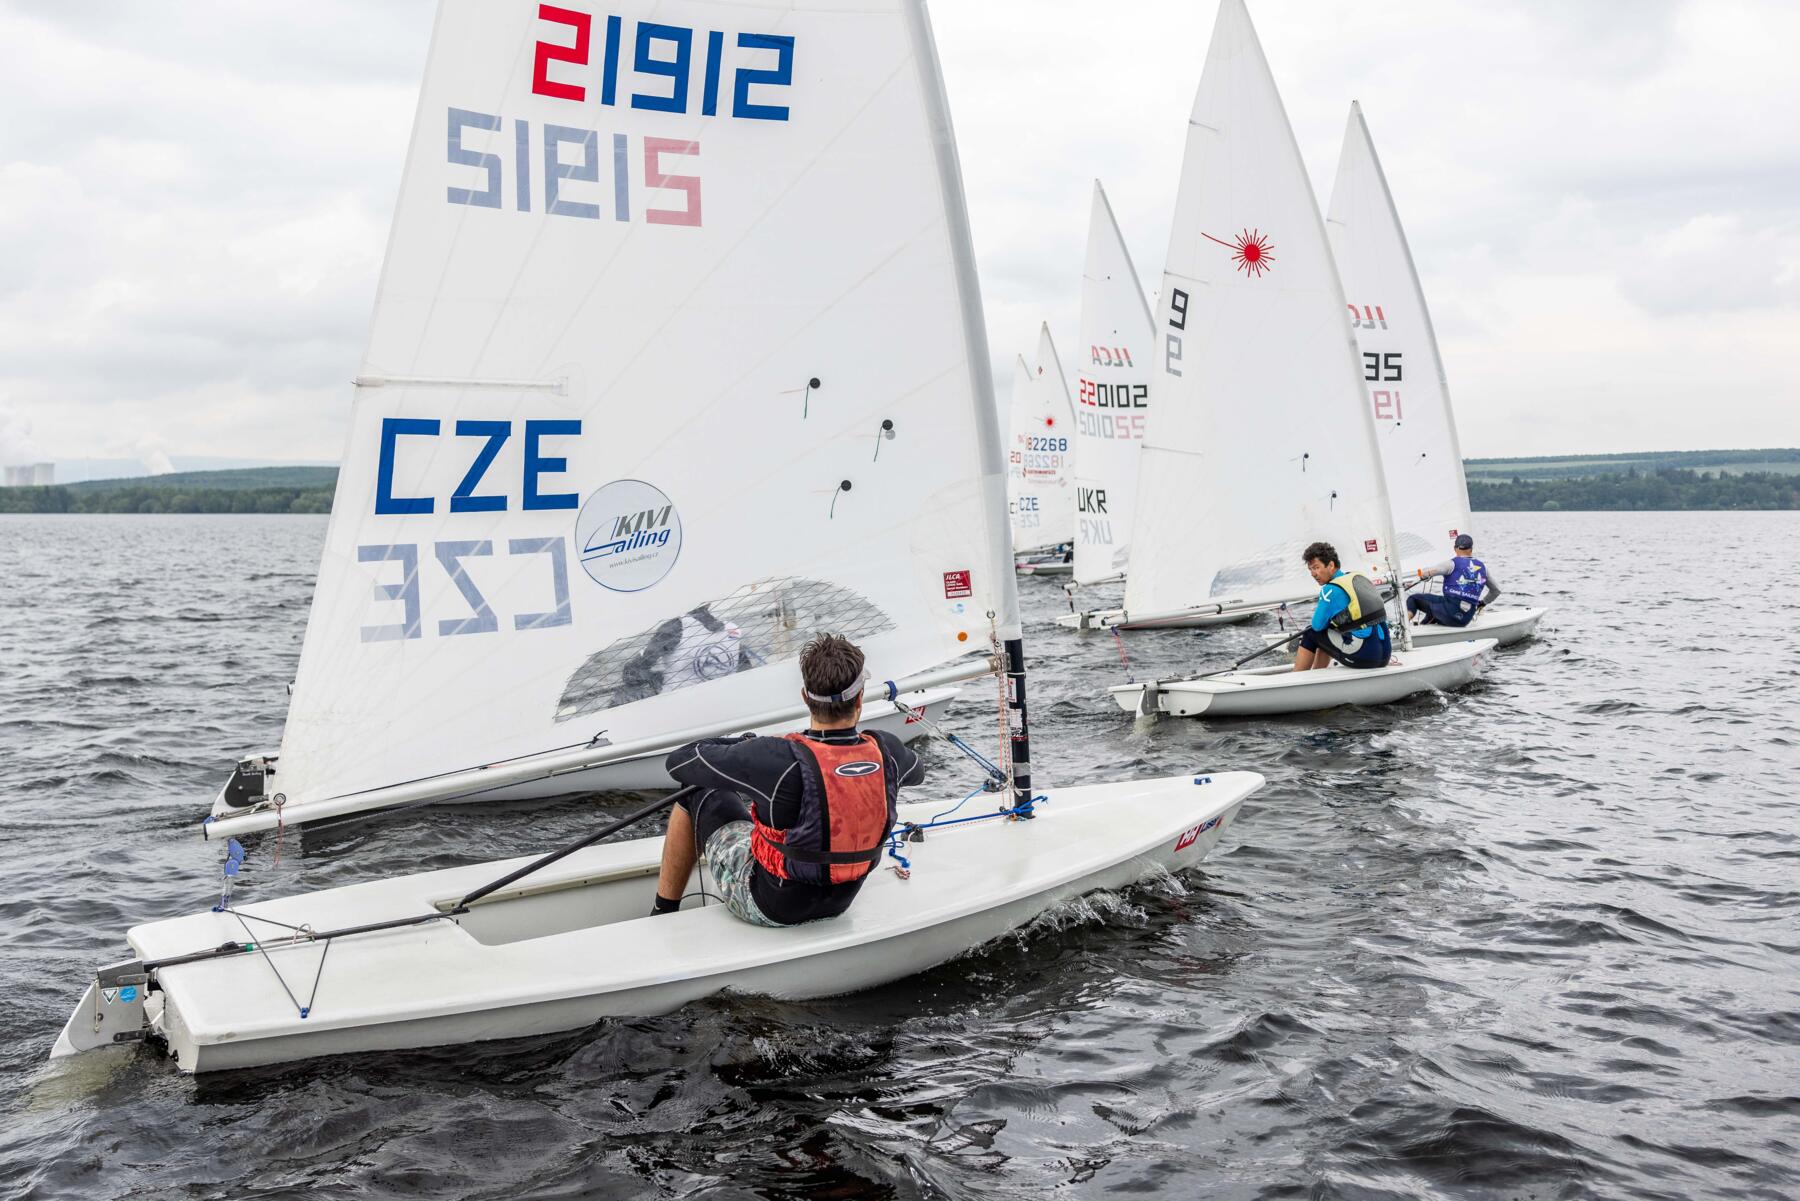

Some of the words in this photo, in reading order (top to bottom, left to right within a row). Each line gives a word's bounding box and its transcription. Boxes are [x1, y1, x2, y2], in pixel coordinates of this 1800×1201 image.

[532, 3, 795, 121] 21912
[1169, 288, 1189, 330] 9
[1363, 352, 1402, 381] 35
[1080, 378, 1148, 408] 220102
[375, 418, 581, 515] CZE
[1020, 497, 1039, 511] CZE
[1077, 487, 1108, 514] UKR
[616, 505, 672, 537] KIVI
[945, 573, 961, 581] ILCA
